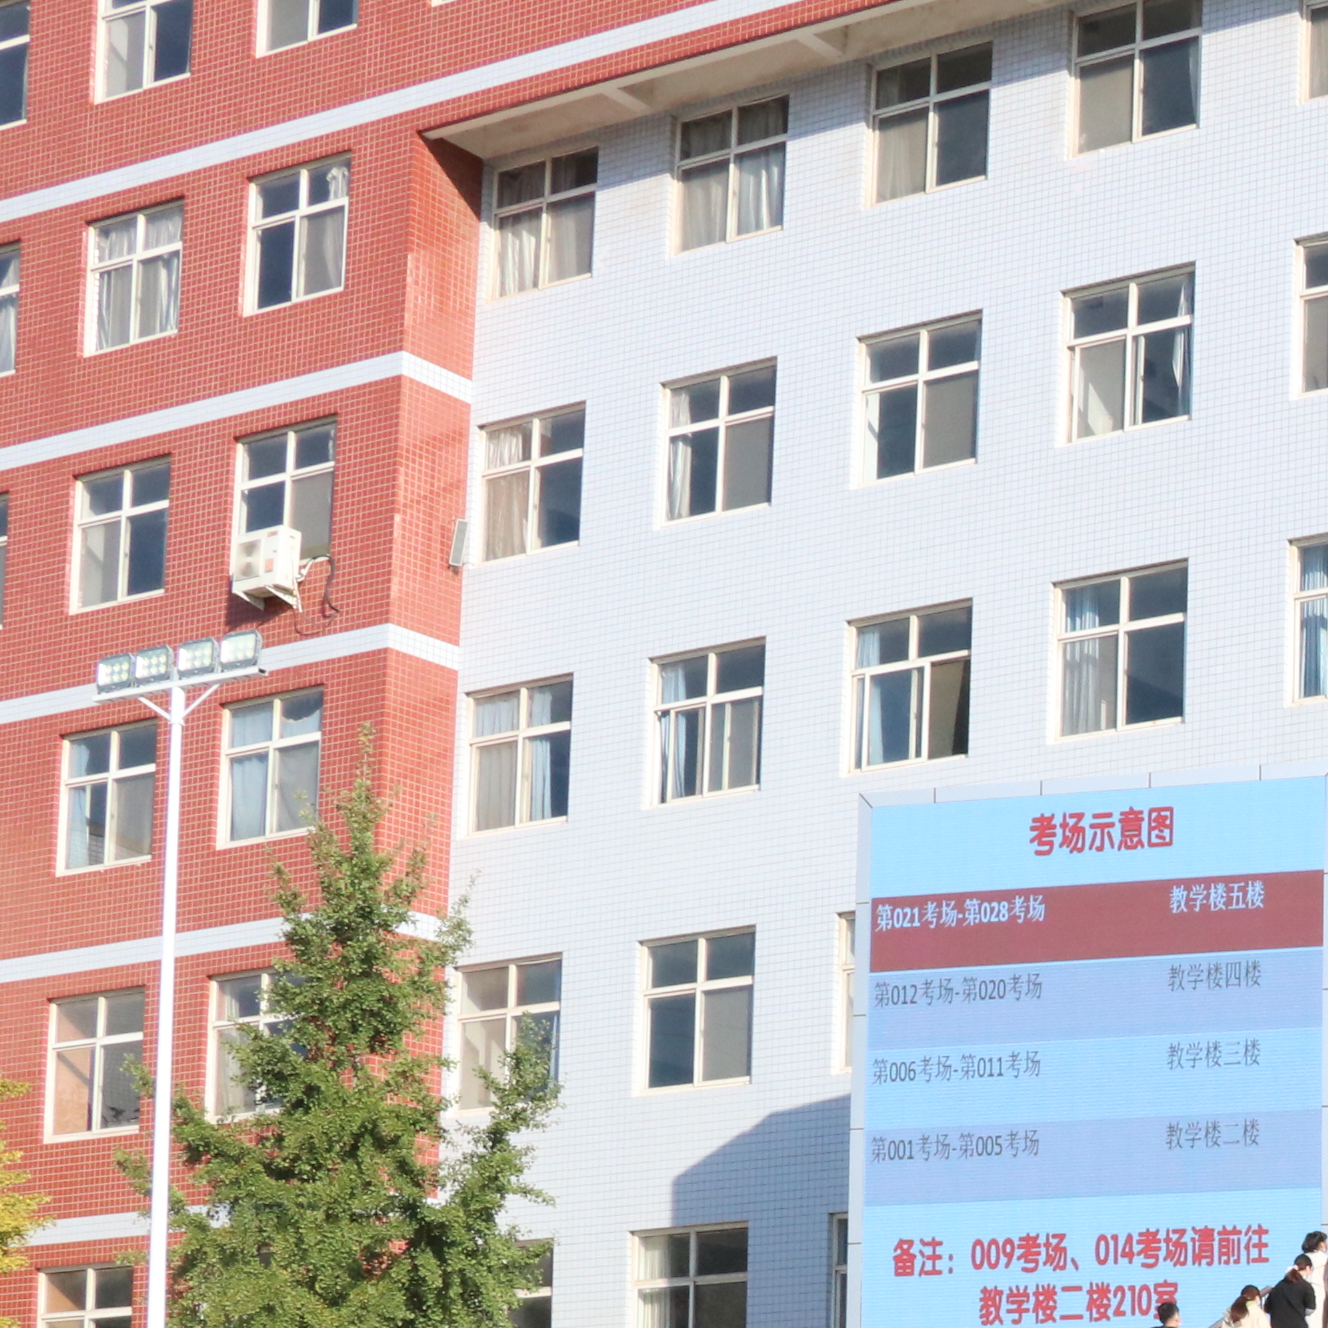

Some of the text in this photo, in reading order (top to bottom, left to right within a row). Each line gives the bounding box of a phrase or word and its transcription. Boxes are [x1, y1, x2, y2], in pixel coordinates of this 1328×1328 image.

[1029, 805, 1174, 857] 考场示意图
[876, 894, 1046, 933] 第021考场-第028考场
[1170, 880, 1265, 914] 教学楼五楼
[874, 972, 1043, 1009] 第012考场-第020考场
[1168, 960, 1262, 992] 教学楼四楼
[872, 1050, 1041, 1085] 第006考场-第011考场
[1167, 1038, 1261, 1071] 教学楼三楼
[871, 1129, 1040, 1163] 第001考场-第005考场
[1165, 1118, 1260, 1151] 教学楼二楼
[978, 1279, 1179, 1327] 教学楼二楼210室
